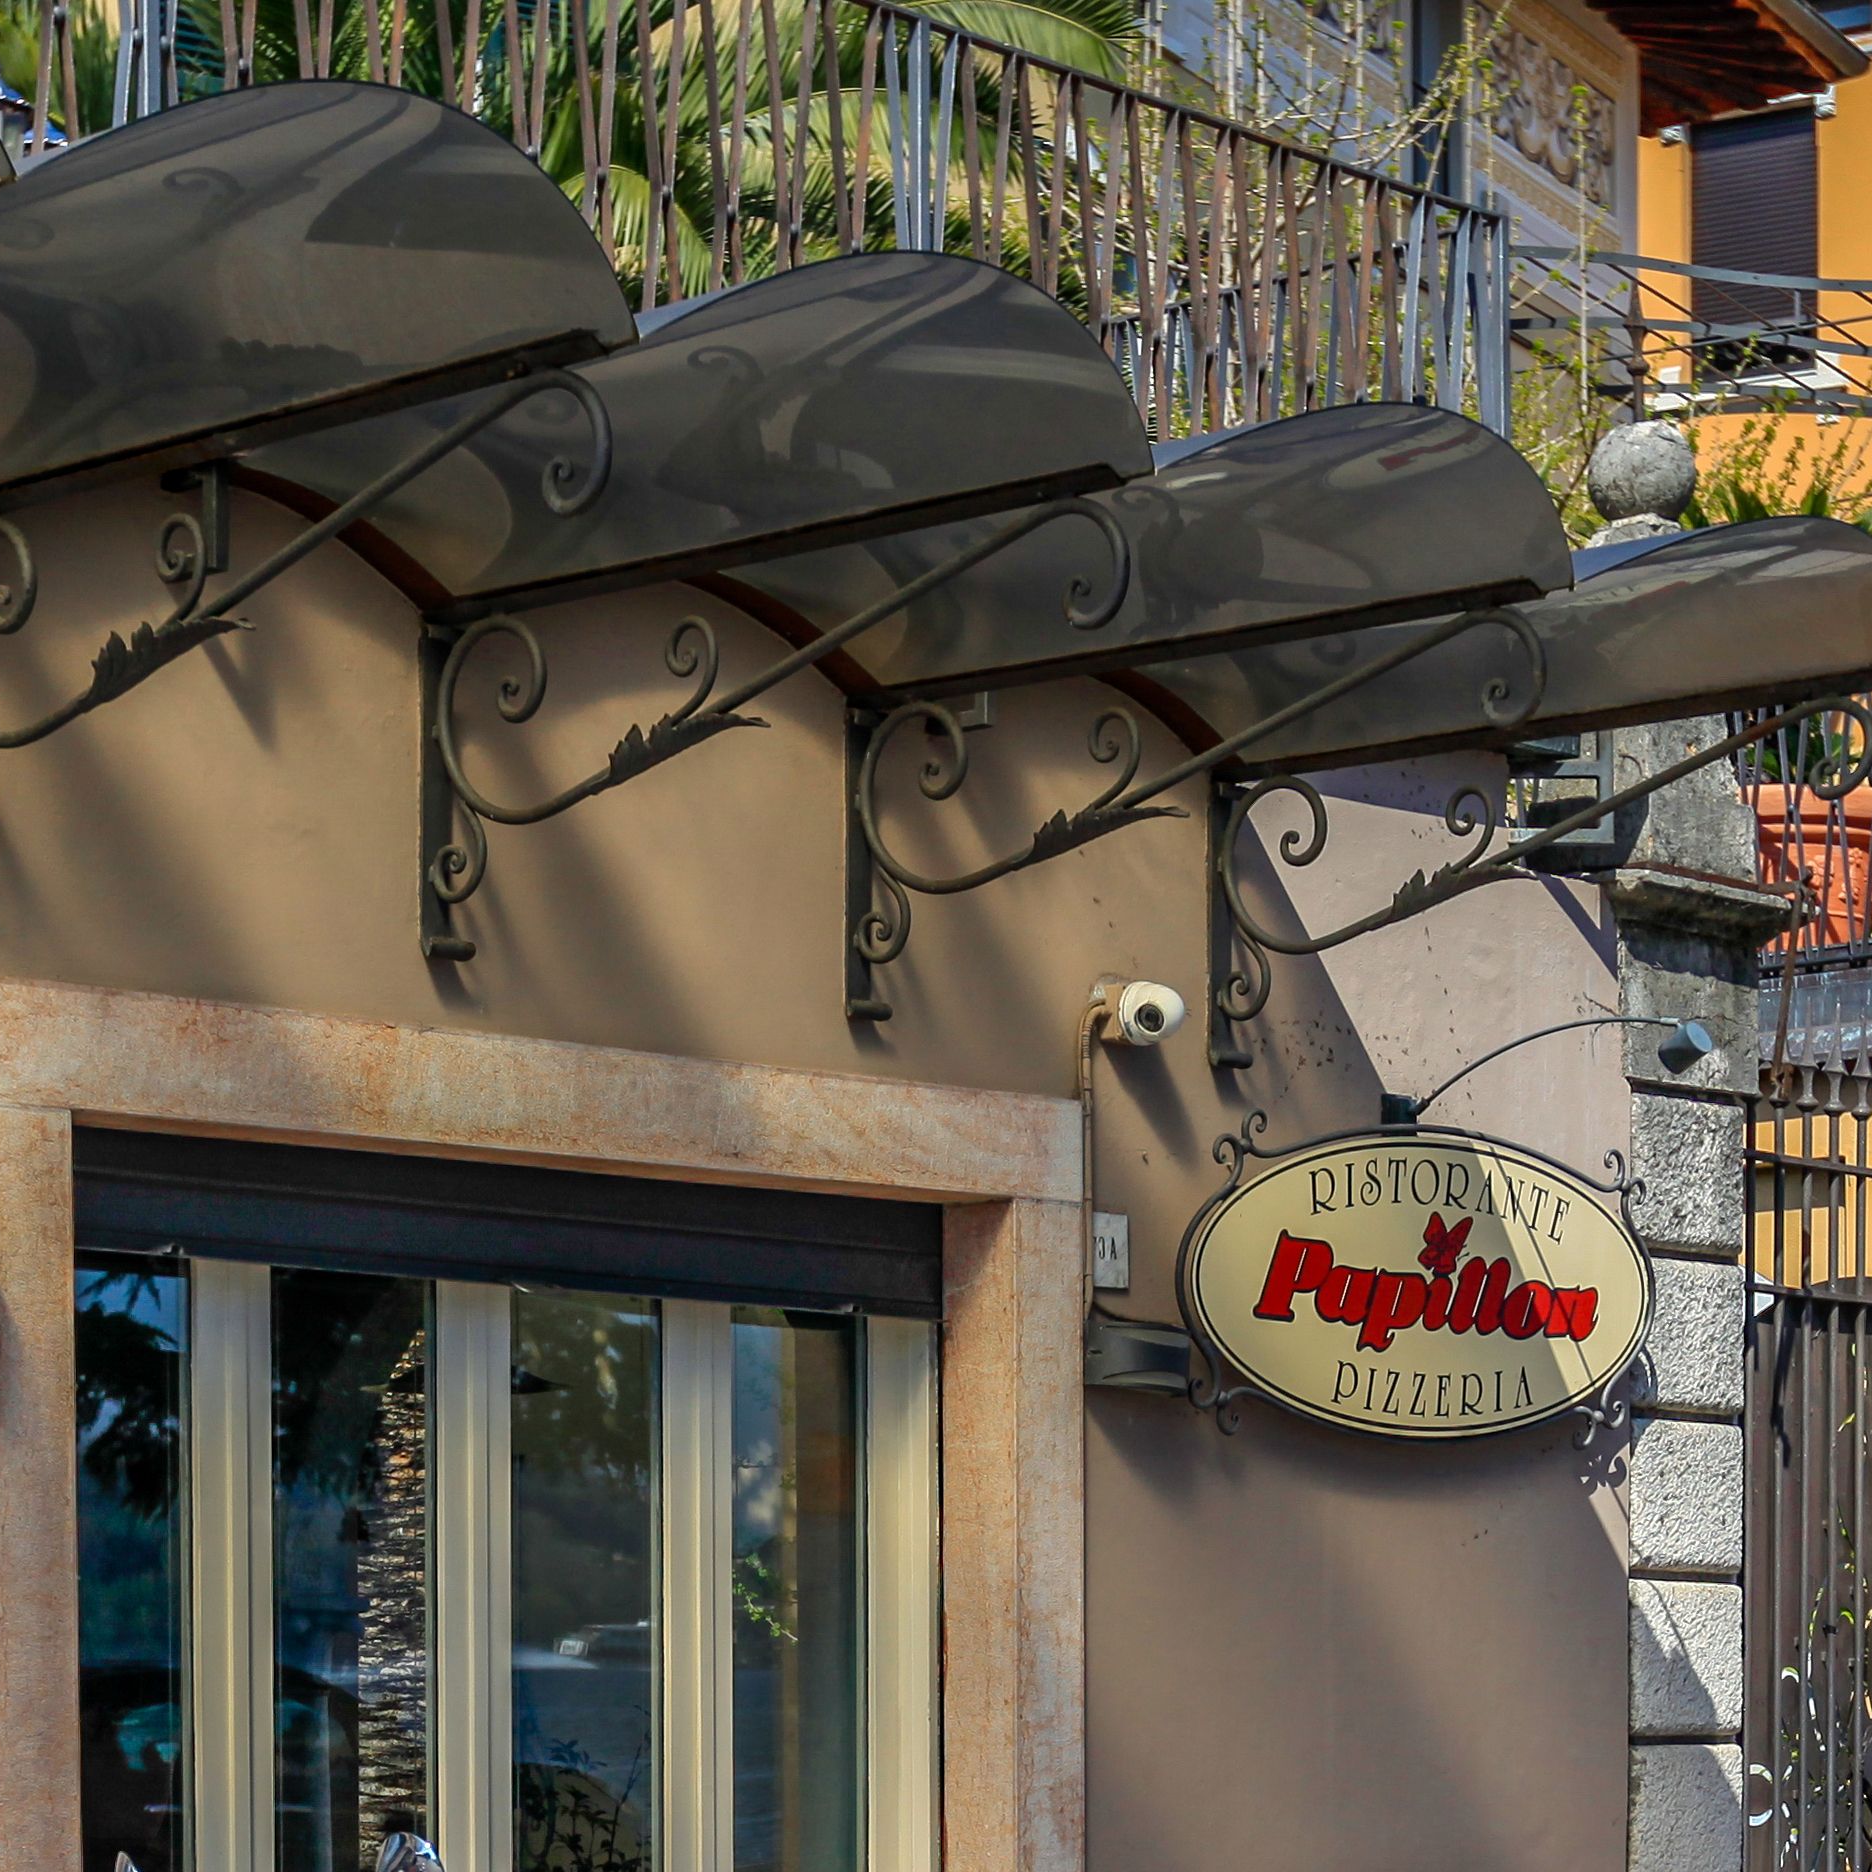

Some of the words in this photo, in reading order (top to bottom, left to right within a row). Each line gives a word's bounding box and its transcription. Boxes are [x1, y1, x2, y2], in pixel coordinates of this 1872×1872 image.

[1309, 1156, 1572, 1246] RISTORANTE
[1252, 1228, 1600, 1353] Papillon
[1330, 1360, 1534, 1419] PIZZERIA
